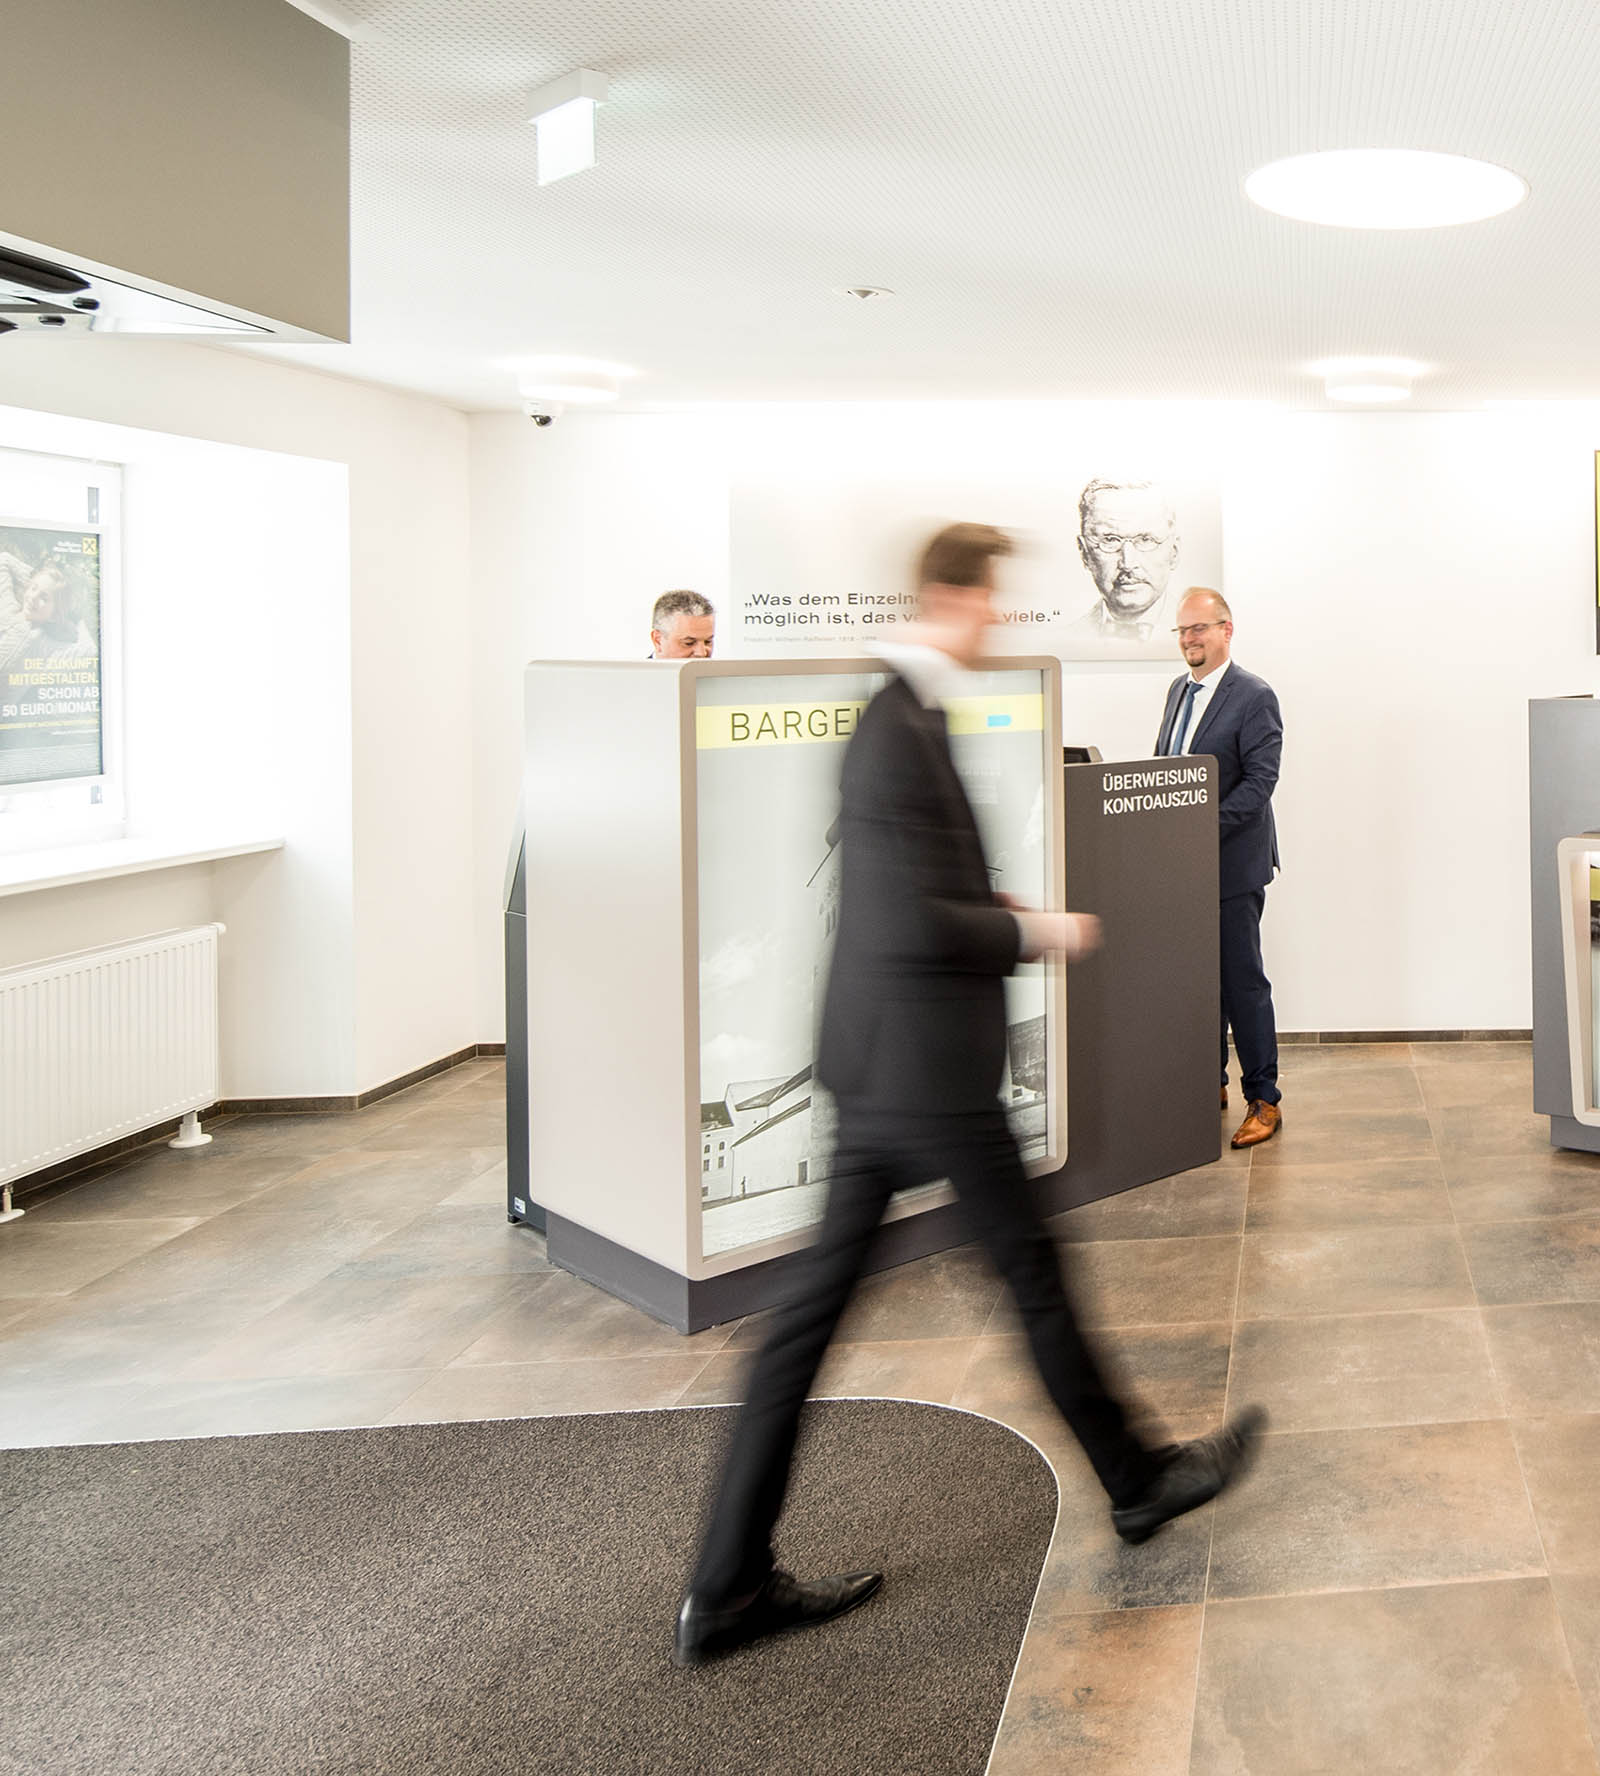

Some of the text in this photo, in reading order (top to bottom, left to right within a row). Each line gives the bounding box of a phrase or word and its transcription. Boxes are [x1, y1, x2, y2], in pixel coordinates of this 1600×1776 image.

[744, 593, 792, 608] „Was
[799, 593, 840, 606] dem
[744, 612, 820, 627] möglich
[827, 611, 855, 626] ist,
[862, 611, 897, 624] das
[24, 657, 99, 670] DIE ZUKUNFT
[8, 672, 99, 686] MITGESTALTEN.
[38, 686, 100, 700] SCHON AB
[2, 704, 18, 717] 50
[1103, 767, 1208, 792] ÜBERWEISUNG
[1103, 788, 1208, 815] KONTOAUSZUG
